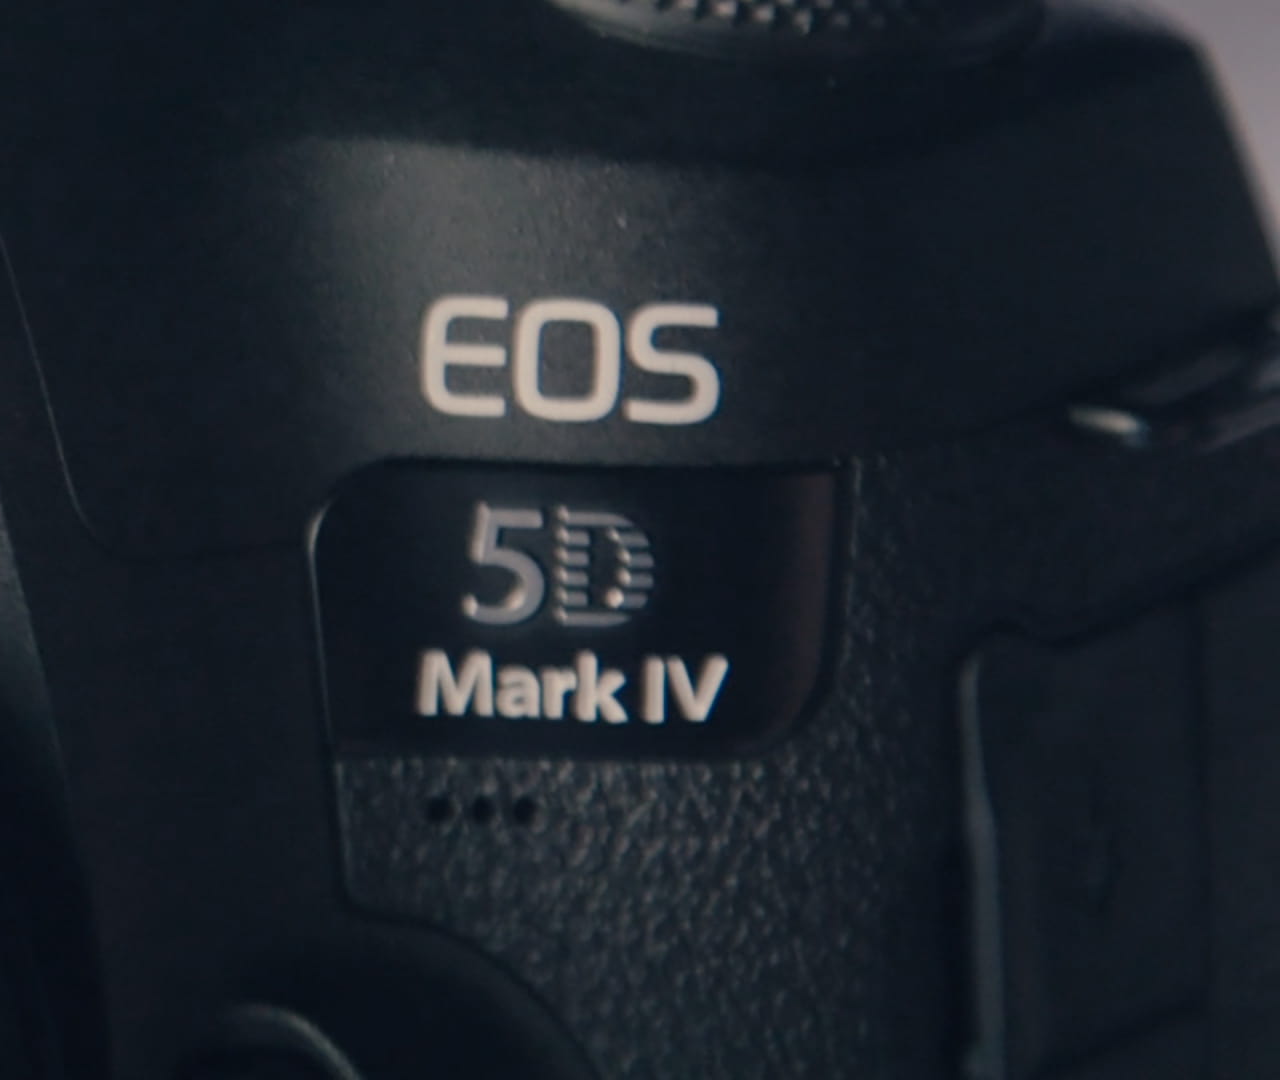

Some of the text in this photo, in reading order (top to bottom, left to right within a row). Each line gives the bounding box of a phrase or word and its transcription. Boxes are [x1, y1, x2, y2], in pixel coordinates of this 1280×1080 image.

[420, 296, 721, 425] EOS
[461, 499, 654, 627] 5D
[415, 648, 730, 723] Mark IV
